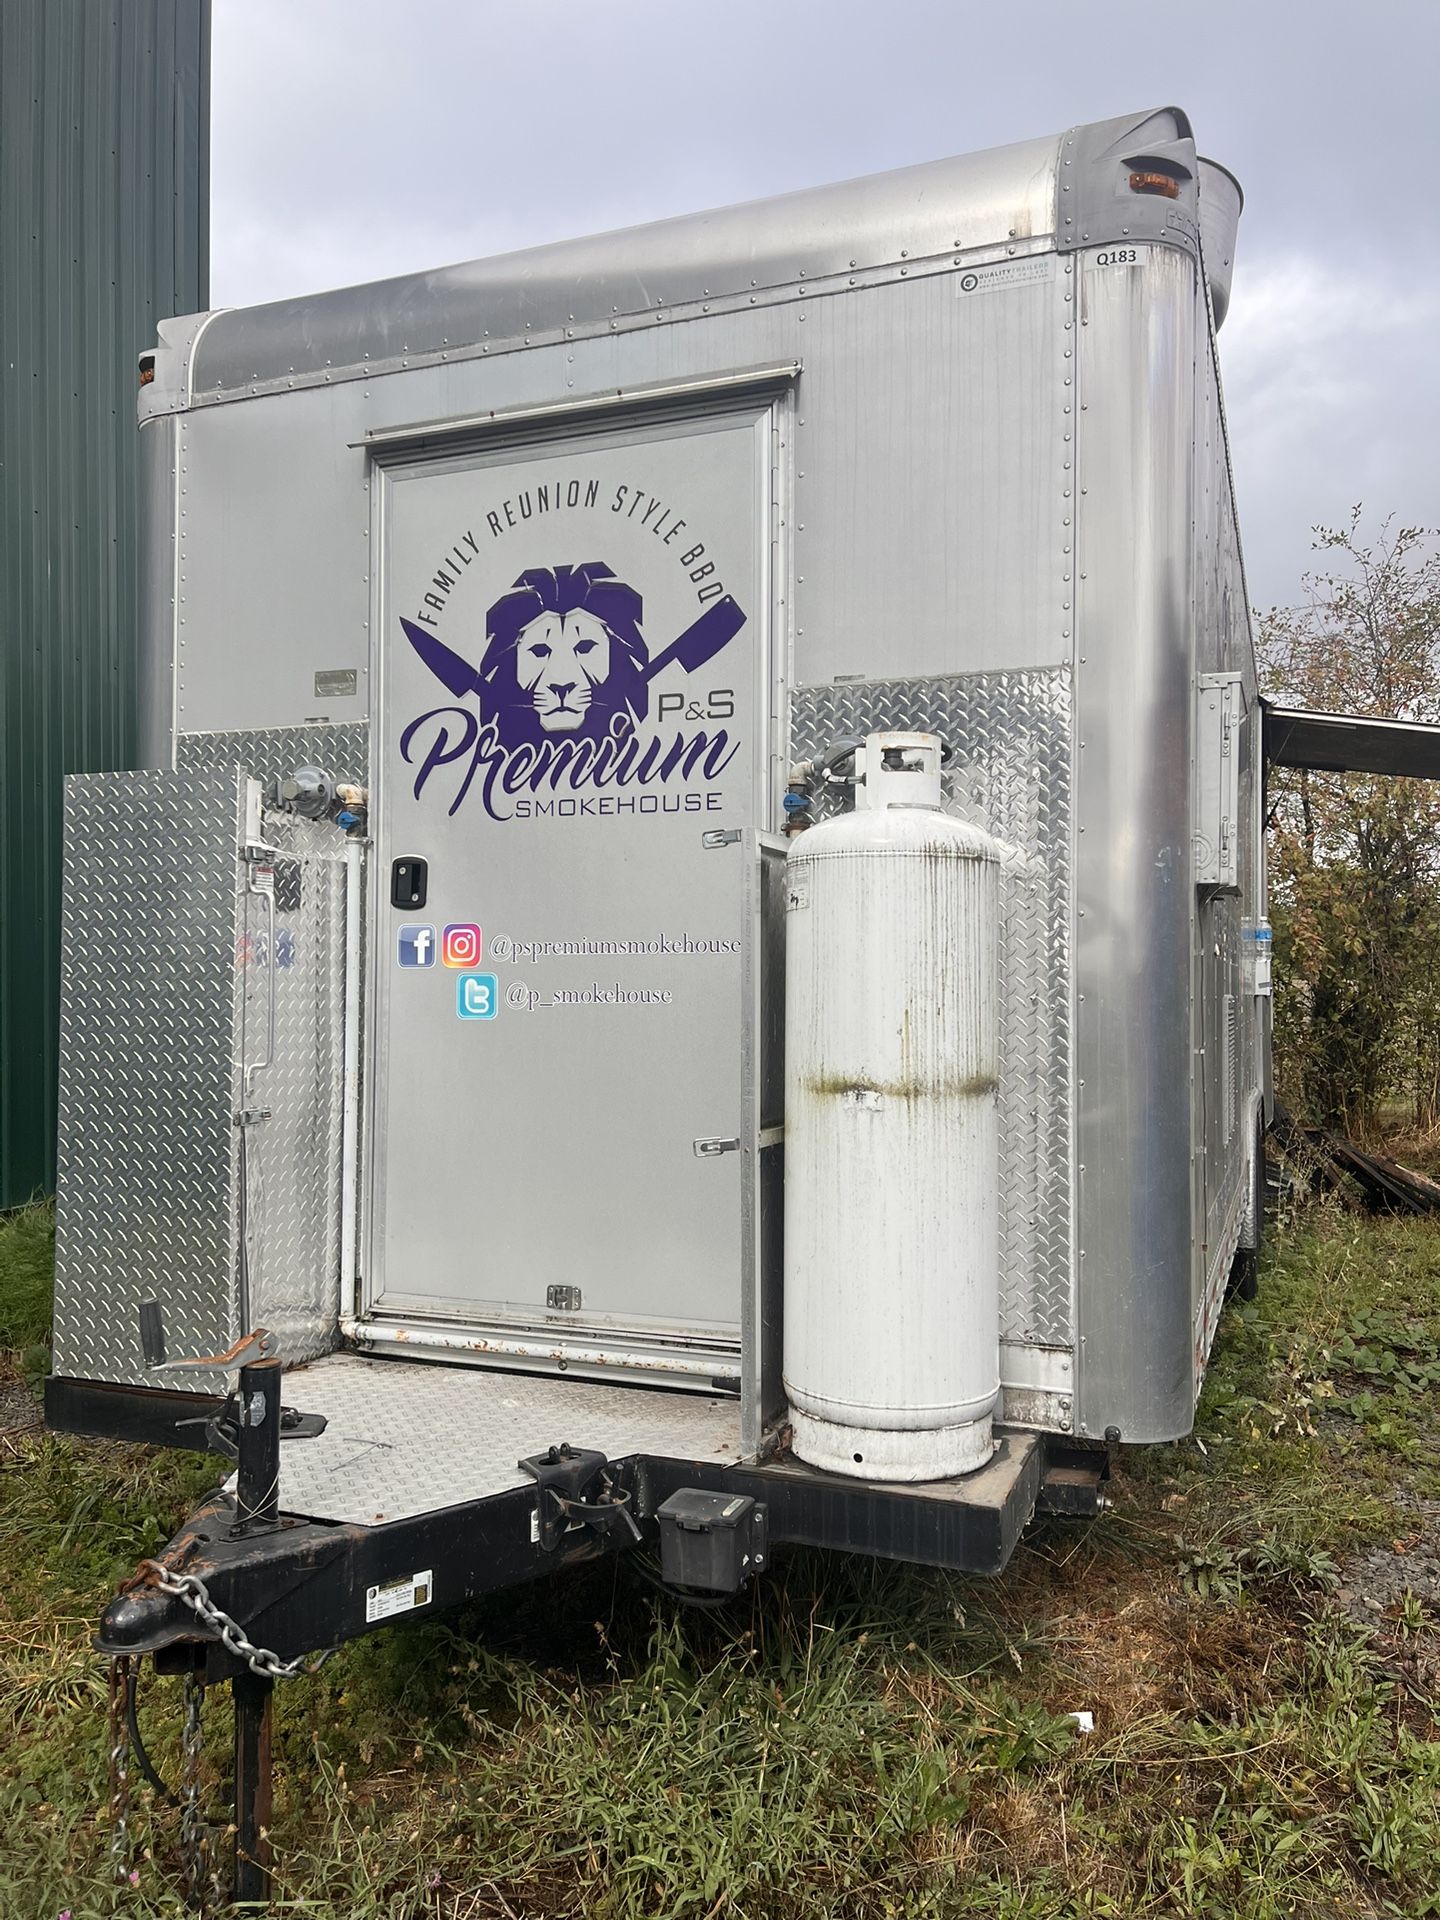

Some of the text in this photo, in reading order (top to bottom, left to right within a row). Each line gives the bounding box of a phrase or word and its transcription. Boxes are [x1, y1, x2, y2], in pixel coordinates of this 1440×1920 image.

[1096, 249, 1137, 266] Q183
[418, 480, 725, 627] FAMILY REUNION STYLE BBQ
[657, 688, 735, 723] P&S
[399, 706, 741, 822] Premium
[514, 792, 723, 819] SMOKEHOUSE
[489, 932, 742, 963] @pspremiumsmokehouse
[505, 980, 673, 1011] @p_smokehouse
